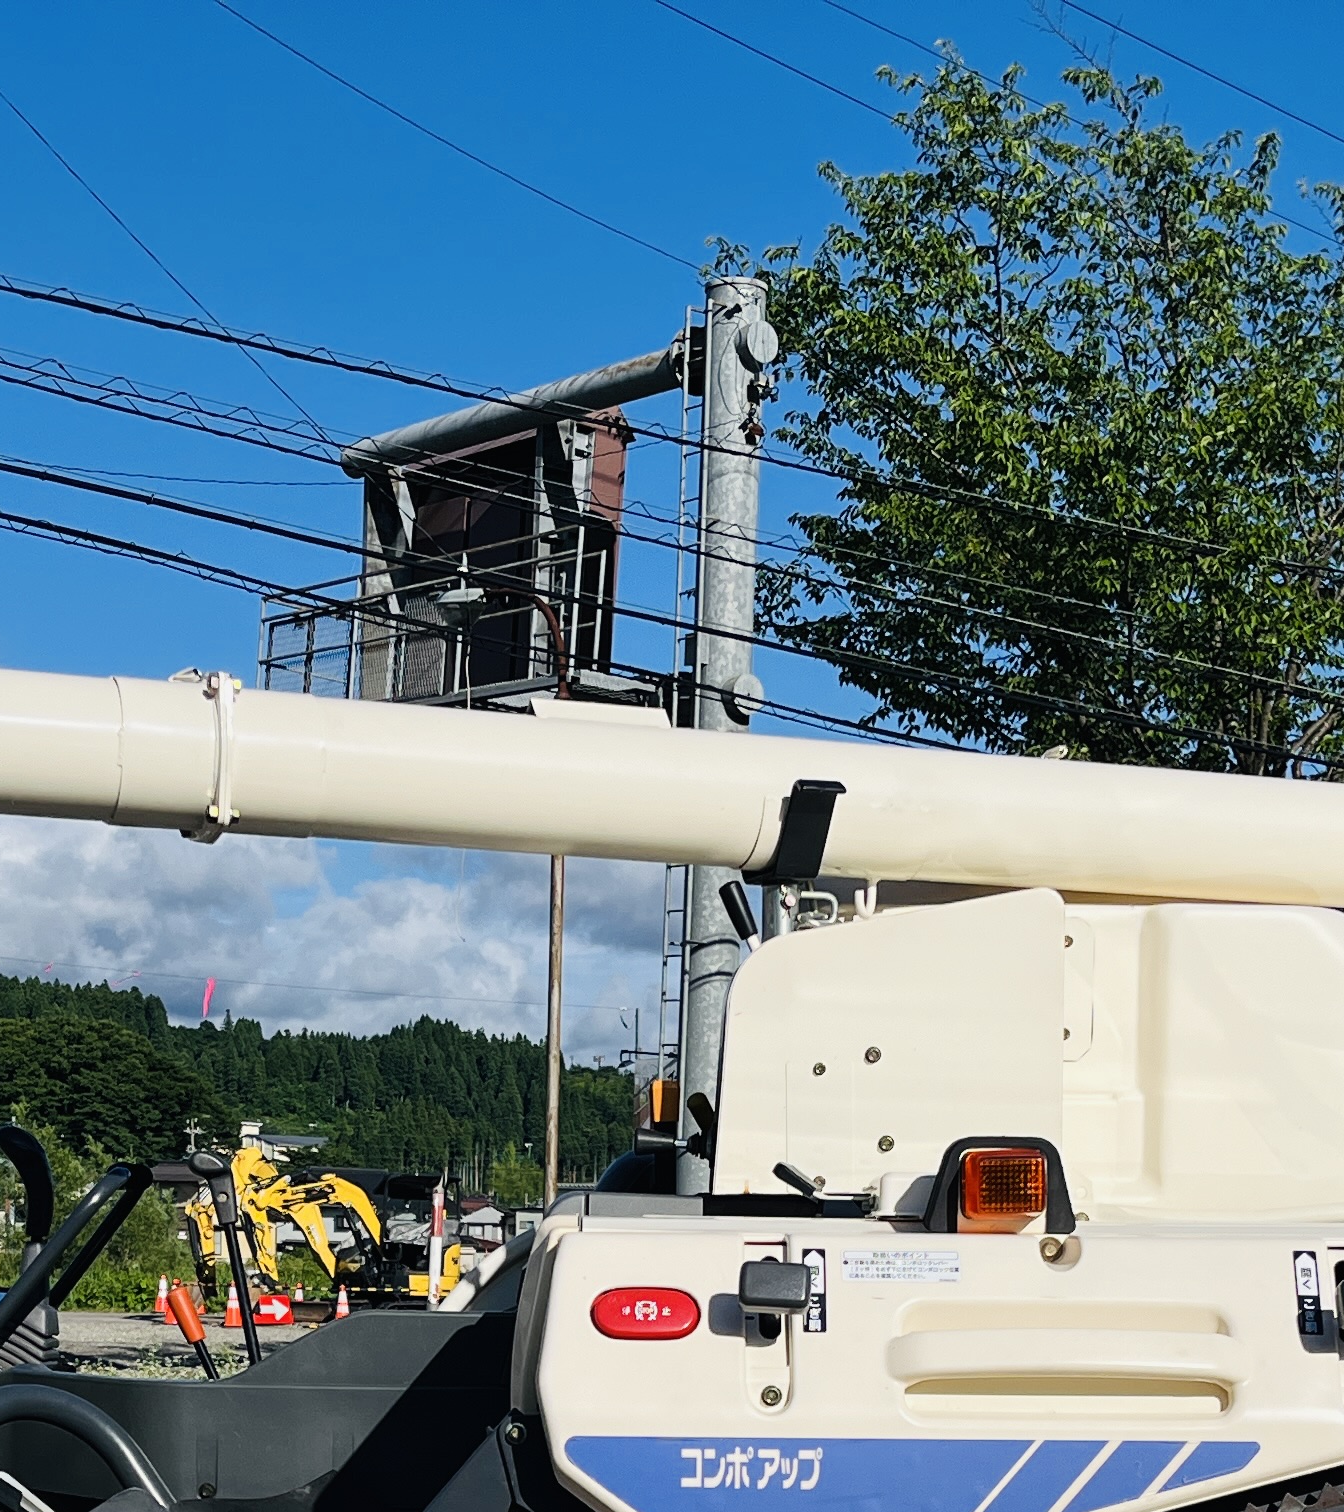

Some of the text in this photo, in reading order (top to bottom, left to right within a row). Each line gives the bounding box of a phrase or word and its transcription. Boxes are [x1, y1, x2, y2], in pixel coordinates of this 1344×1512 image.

[680, 1446, 824, 1490] コンポアップ
